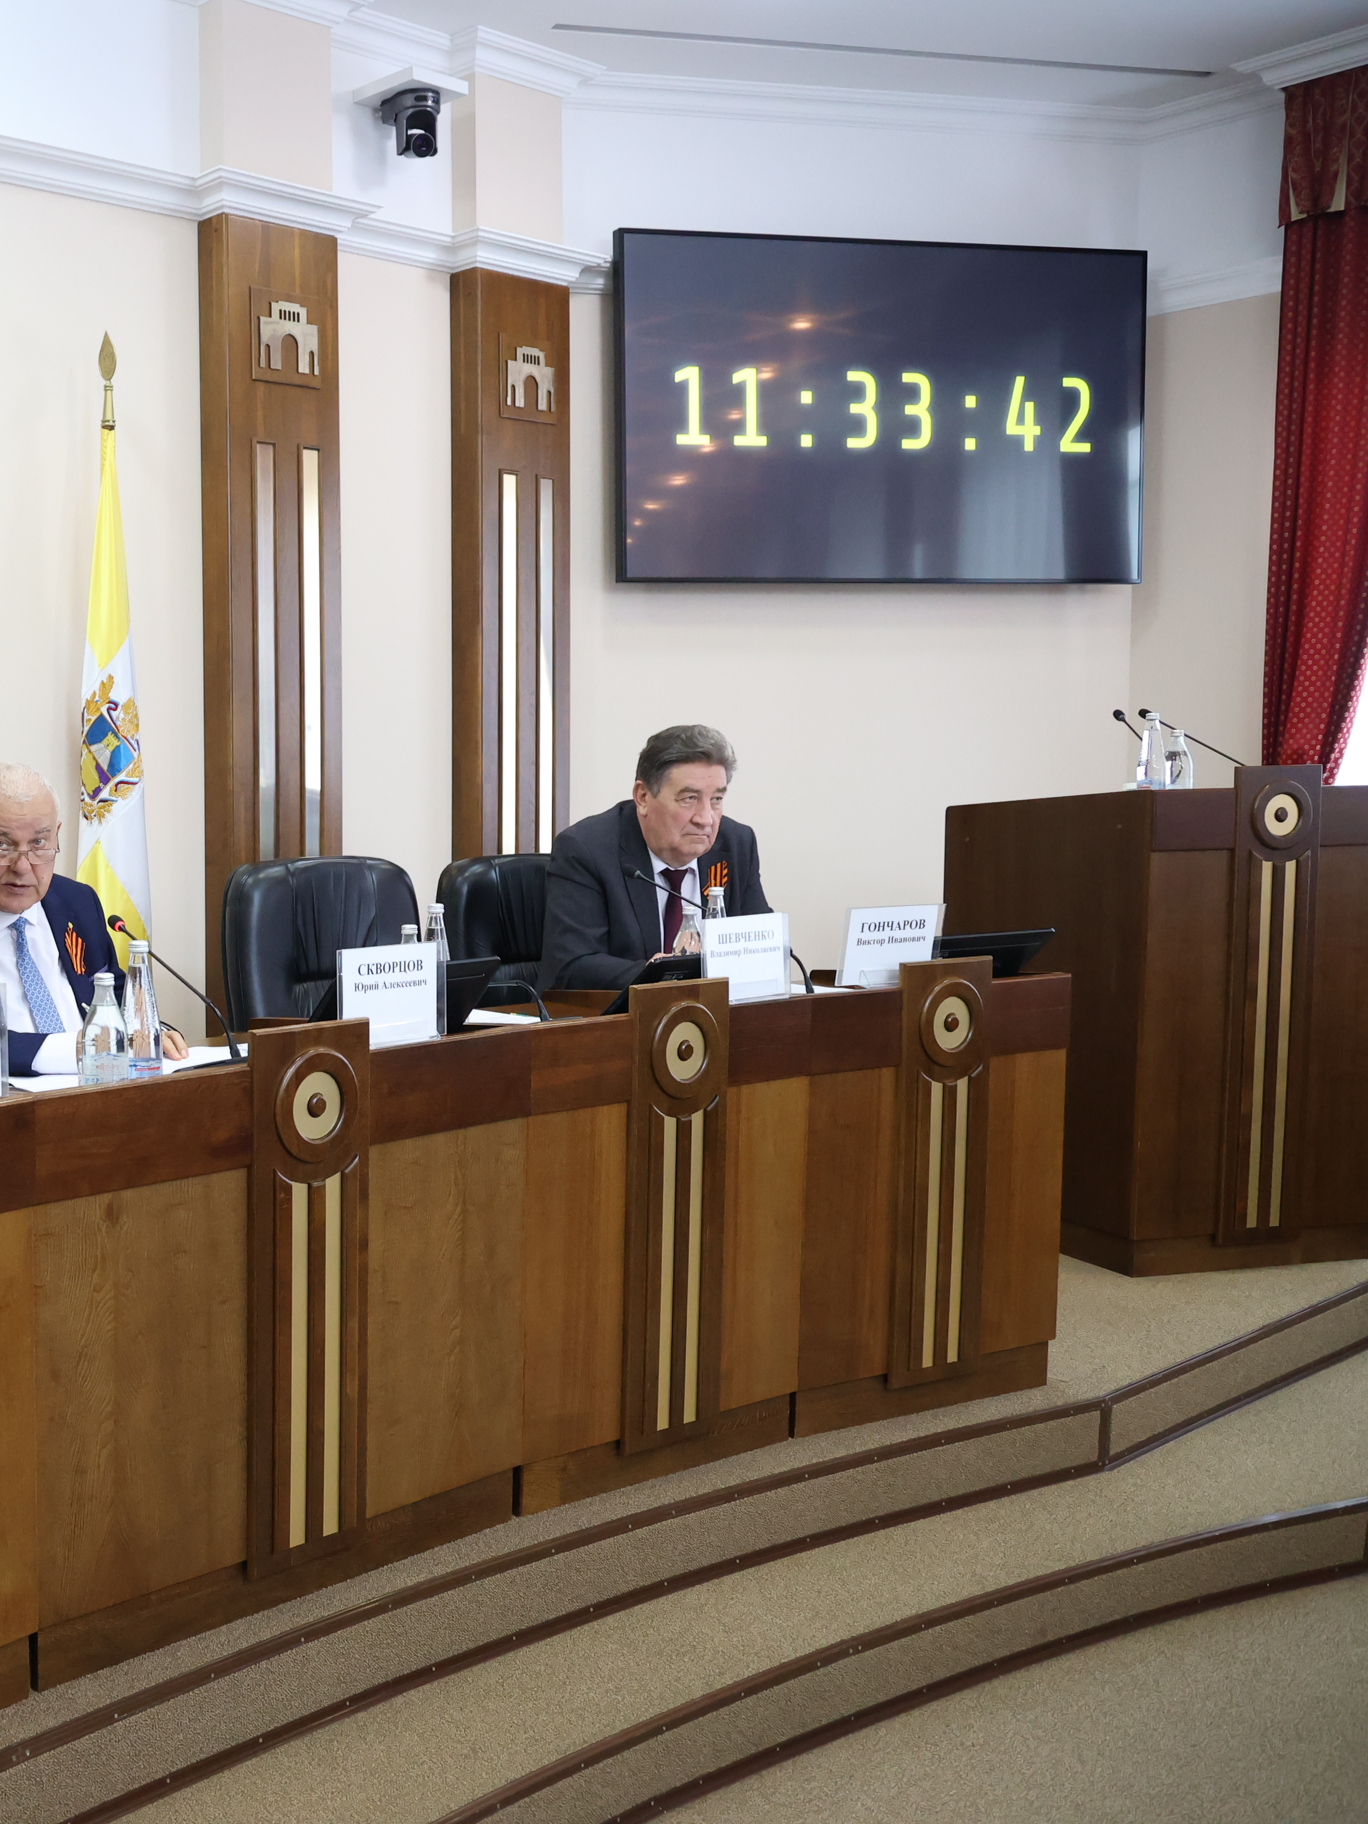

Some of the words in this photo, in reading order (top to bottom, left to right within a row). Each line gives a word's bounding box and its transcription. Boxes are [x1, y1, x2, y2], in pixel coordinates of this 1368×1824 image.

[674, 366, 1092, 453] 11:33:42
[860, 919, 926, 934] ГОНЧАРОВ
[718, 929, 774, 945] ШЕВЧЕНКО
[856, 937, 886, 947] Виктор
[887, 935, 926, 944] Иванович
[710, 949, 742, 958] Владимир
[743, 945, 781, 955] Николаевич
[357, 959, 424, 976] СКВОРЦОВ
[354, 981, 379, 994] Юрий
[382, 979, 427, 990] Алексеевич
